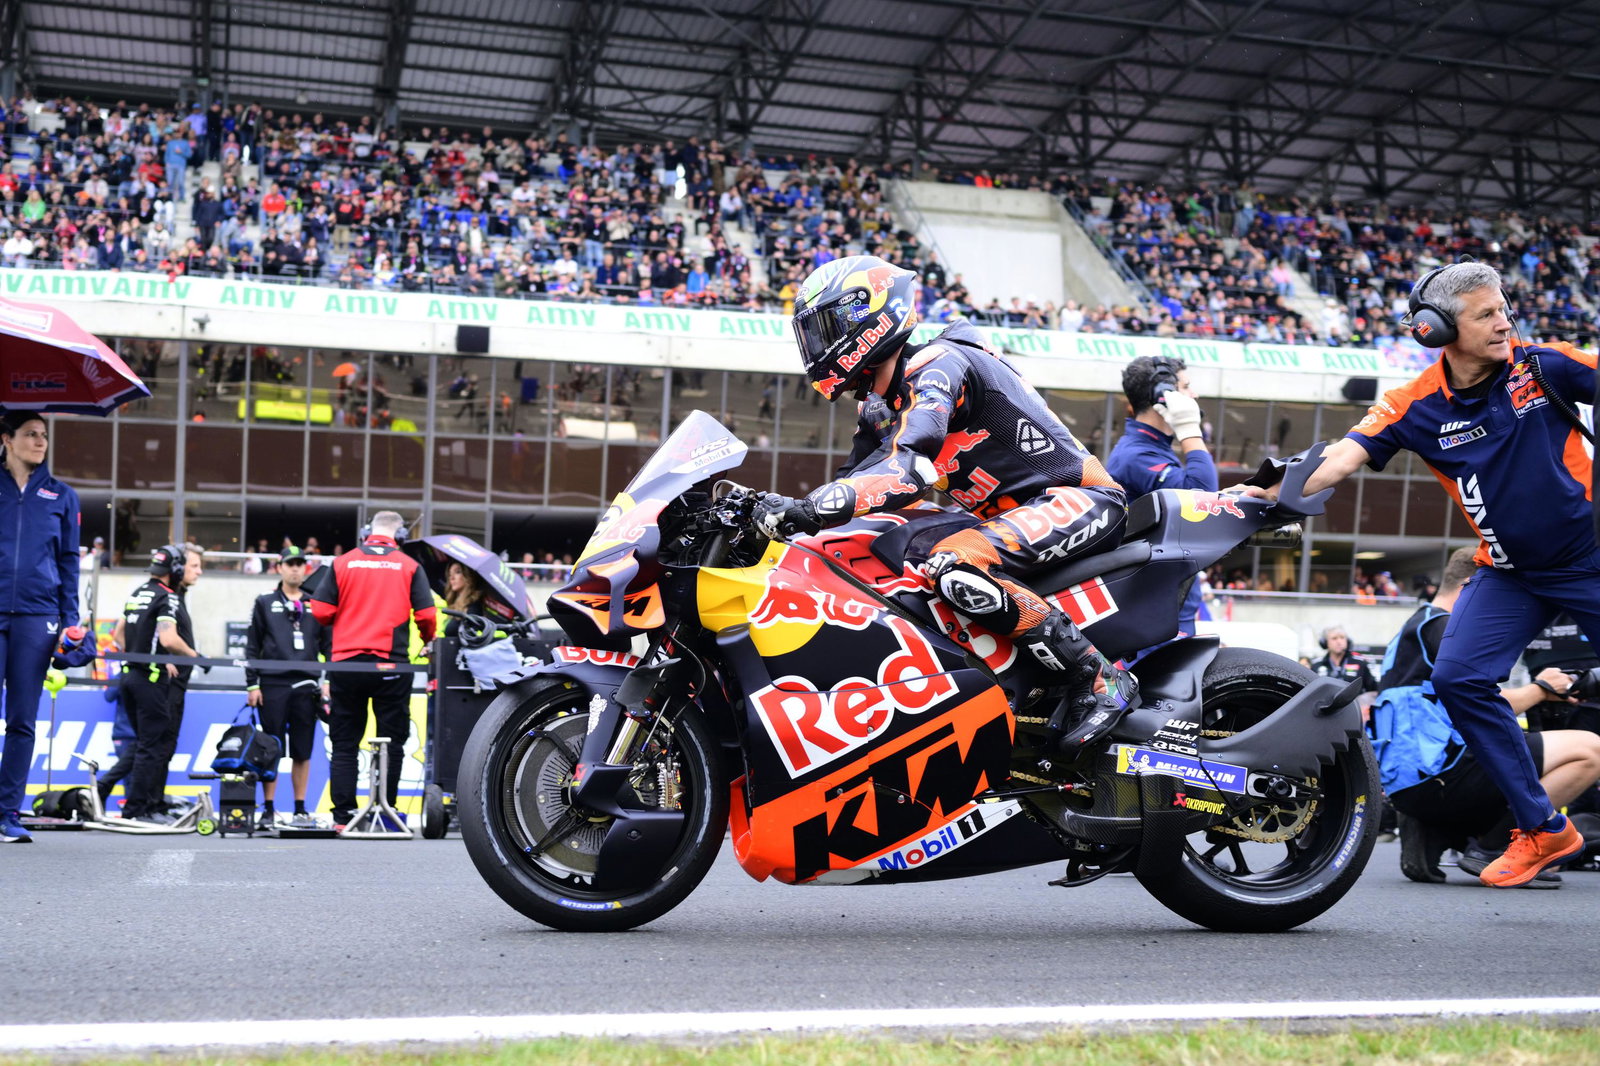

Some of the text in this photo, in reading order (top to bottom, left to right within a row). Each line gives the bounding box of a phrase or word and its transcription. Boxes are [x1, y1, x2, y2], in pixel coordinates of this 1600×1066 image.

[837, 336, 871, 372] Red
[861, 312, 893, 347] Bull
[1441, 433, 1472, 448] Mobil
[950, 466, 1000, 509] Bull
[1000, 486, 1096, 545] Bull
[558, 646, 642, 668] Bull
[749, 614, 959, 779] Red
[1165, 719, 1199, 731] WP
[1155, 761, 1236, 784] MICHELIN
[793, 711, 1015, 882] KTM
[878, 827, 958, 871] Mobil
[1334, 815, 1363, 868] MICHELIN
